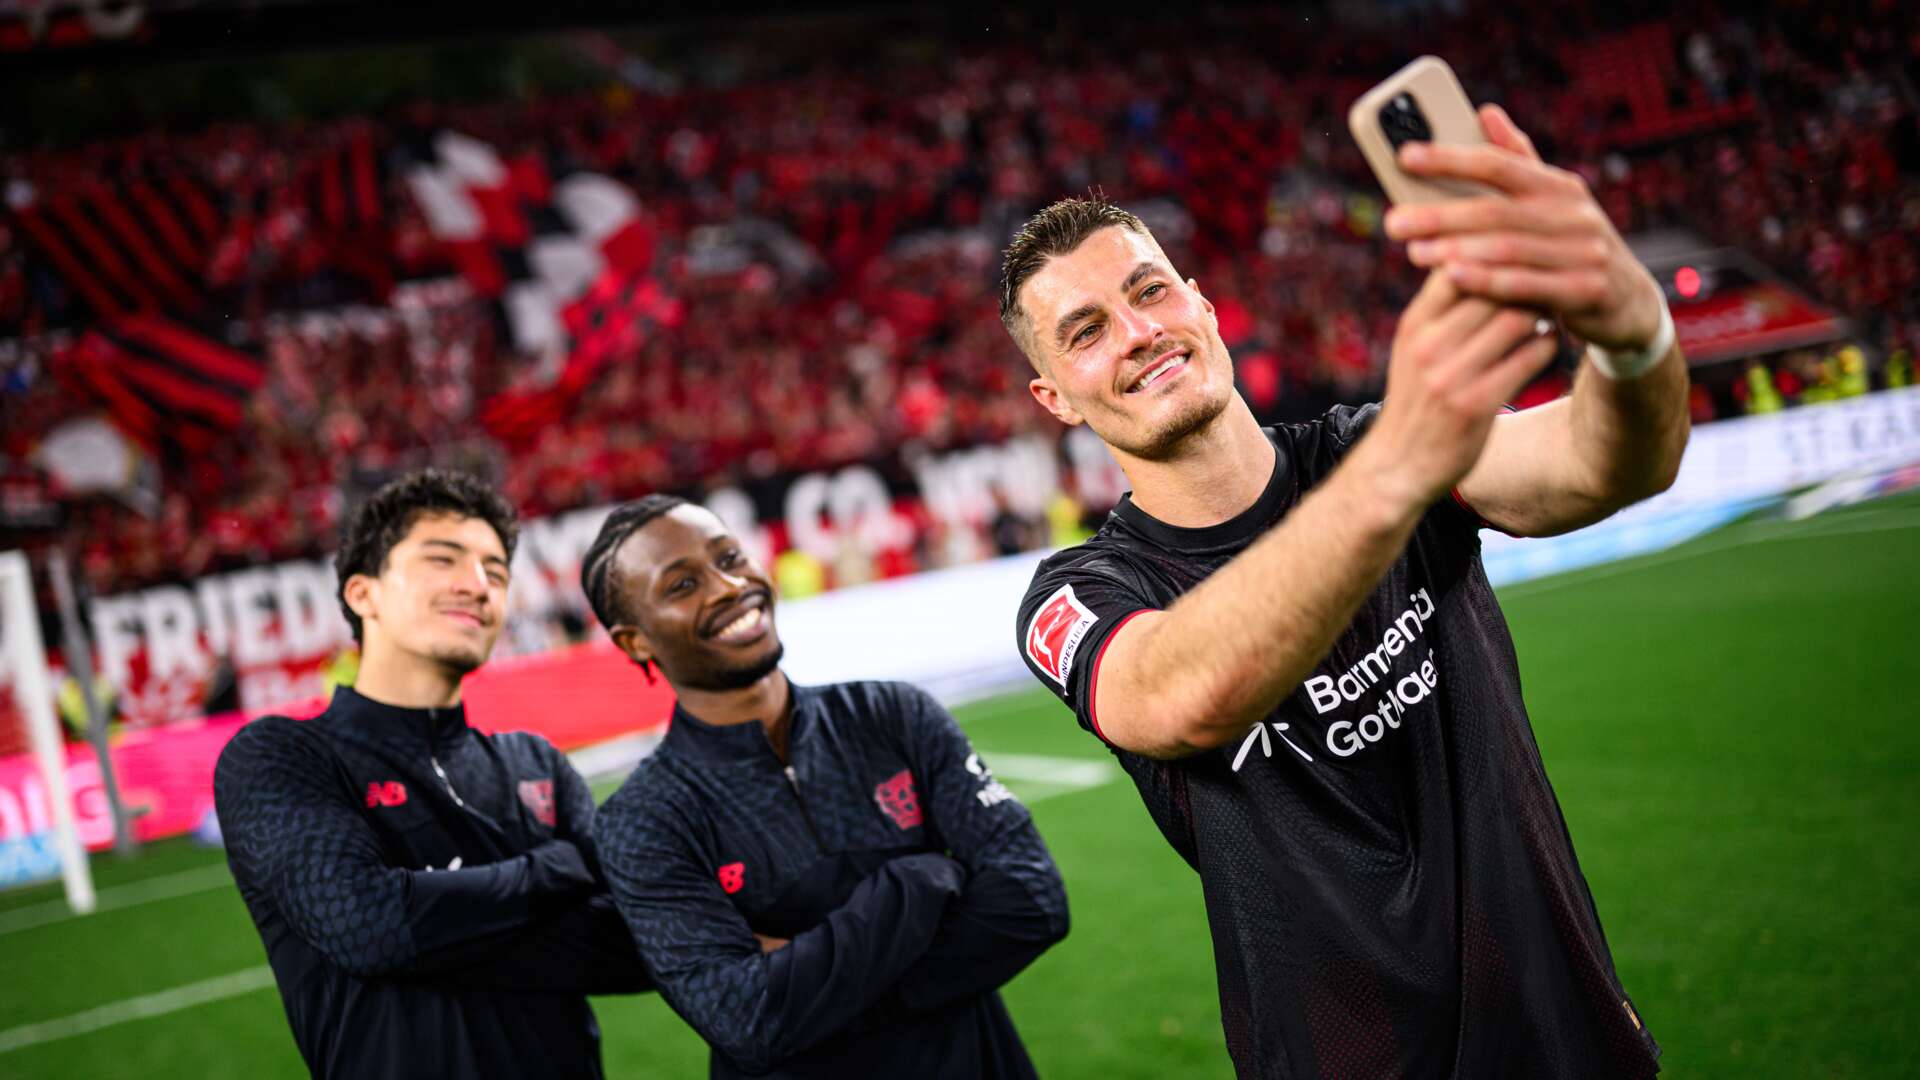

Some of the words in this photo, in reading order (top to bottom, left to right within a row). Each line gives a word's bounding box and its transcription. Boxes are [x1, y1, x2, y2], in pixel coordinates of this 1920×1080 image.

[92, 556, 350, 692] FRIED
[1063, 620, 1090, 682] UNDESLIGA
[1304, 587, 1435, 715] Barmenia
